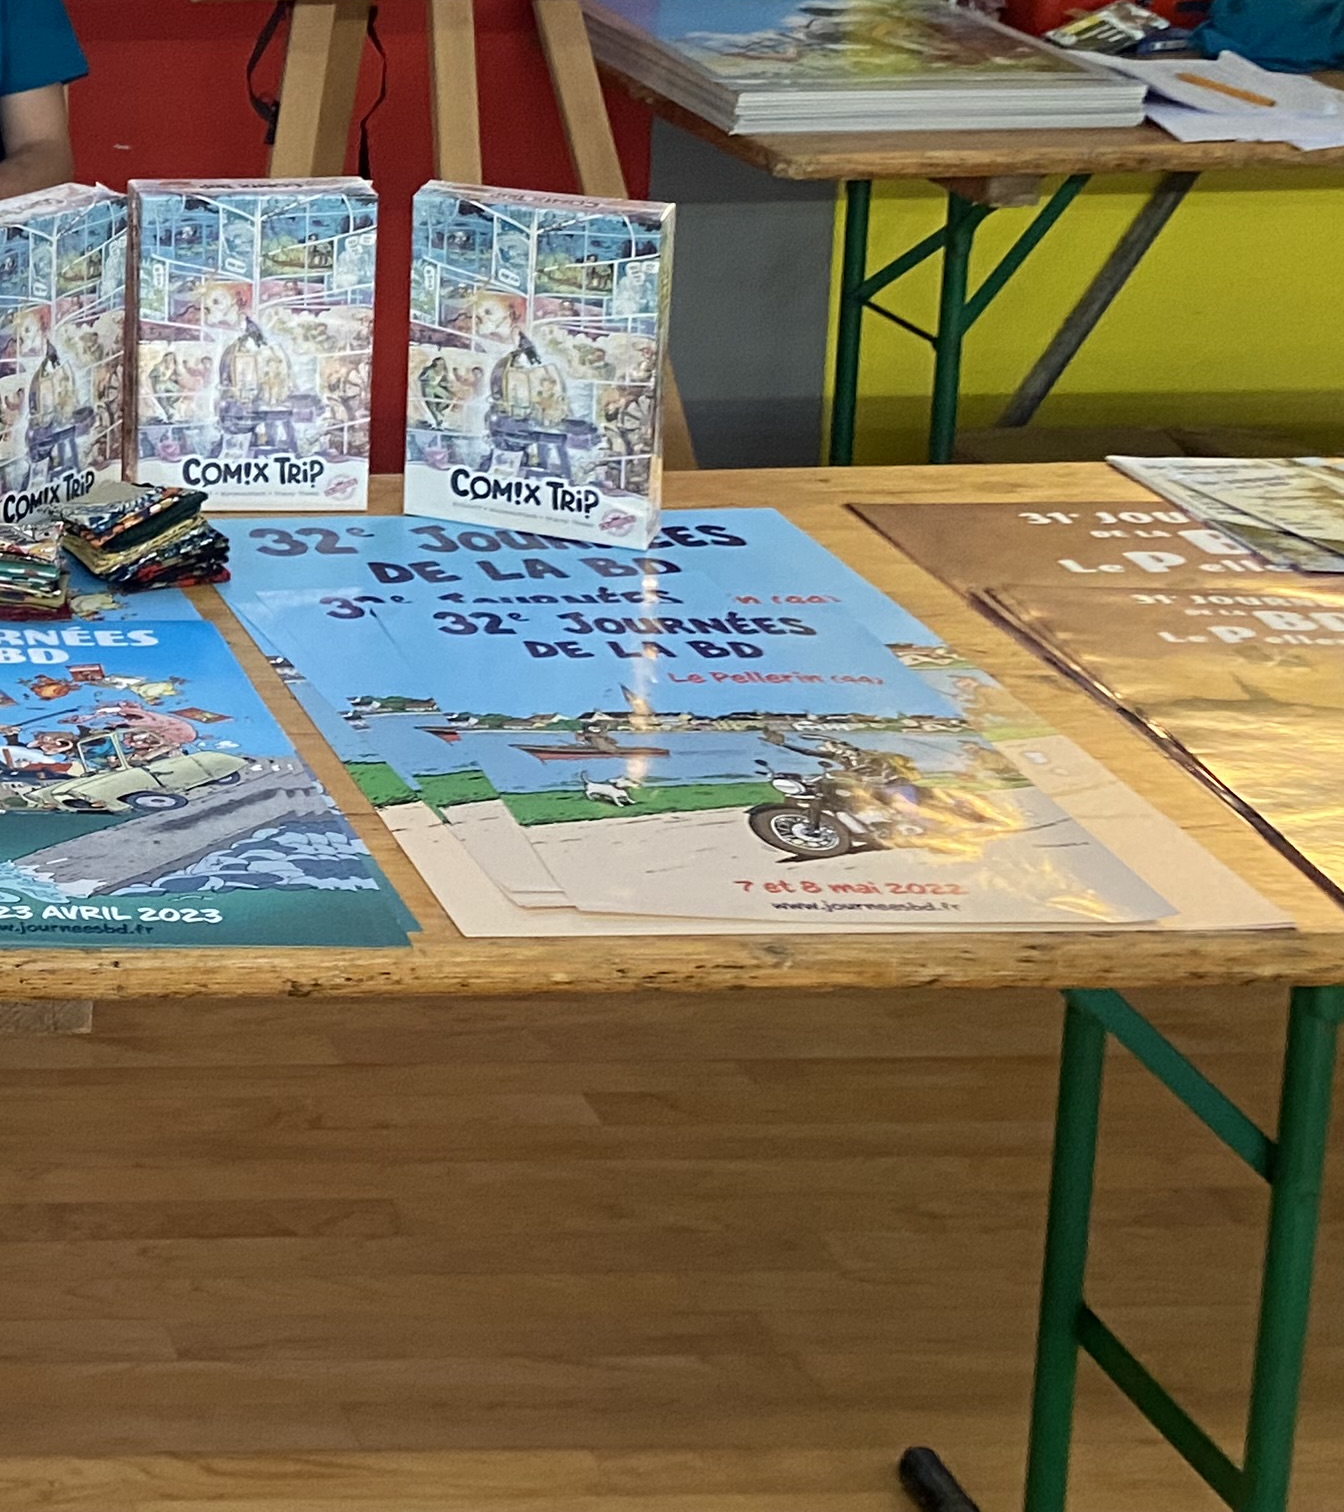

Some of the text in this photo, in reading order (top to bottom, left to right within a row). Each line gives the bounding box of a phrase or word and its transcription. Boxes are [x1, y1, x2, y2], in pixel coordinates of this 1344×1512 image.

[367, 555, 683, 584] DE LA BD
[1057, 558, 1126, 574] Le
[562, 610, 817, 637] JOURNÉES
[523, 640, 765, 660] DE LA BD
[669, 671, 817, 686] Le Pellerin
[732, 879, 970, 896] 7 et 8 mai 2022
[41, 904, 132, 921] AVRIL
[137, 906, 224, 924] 2023
